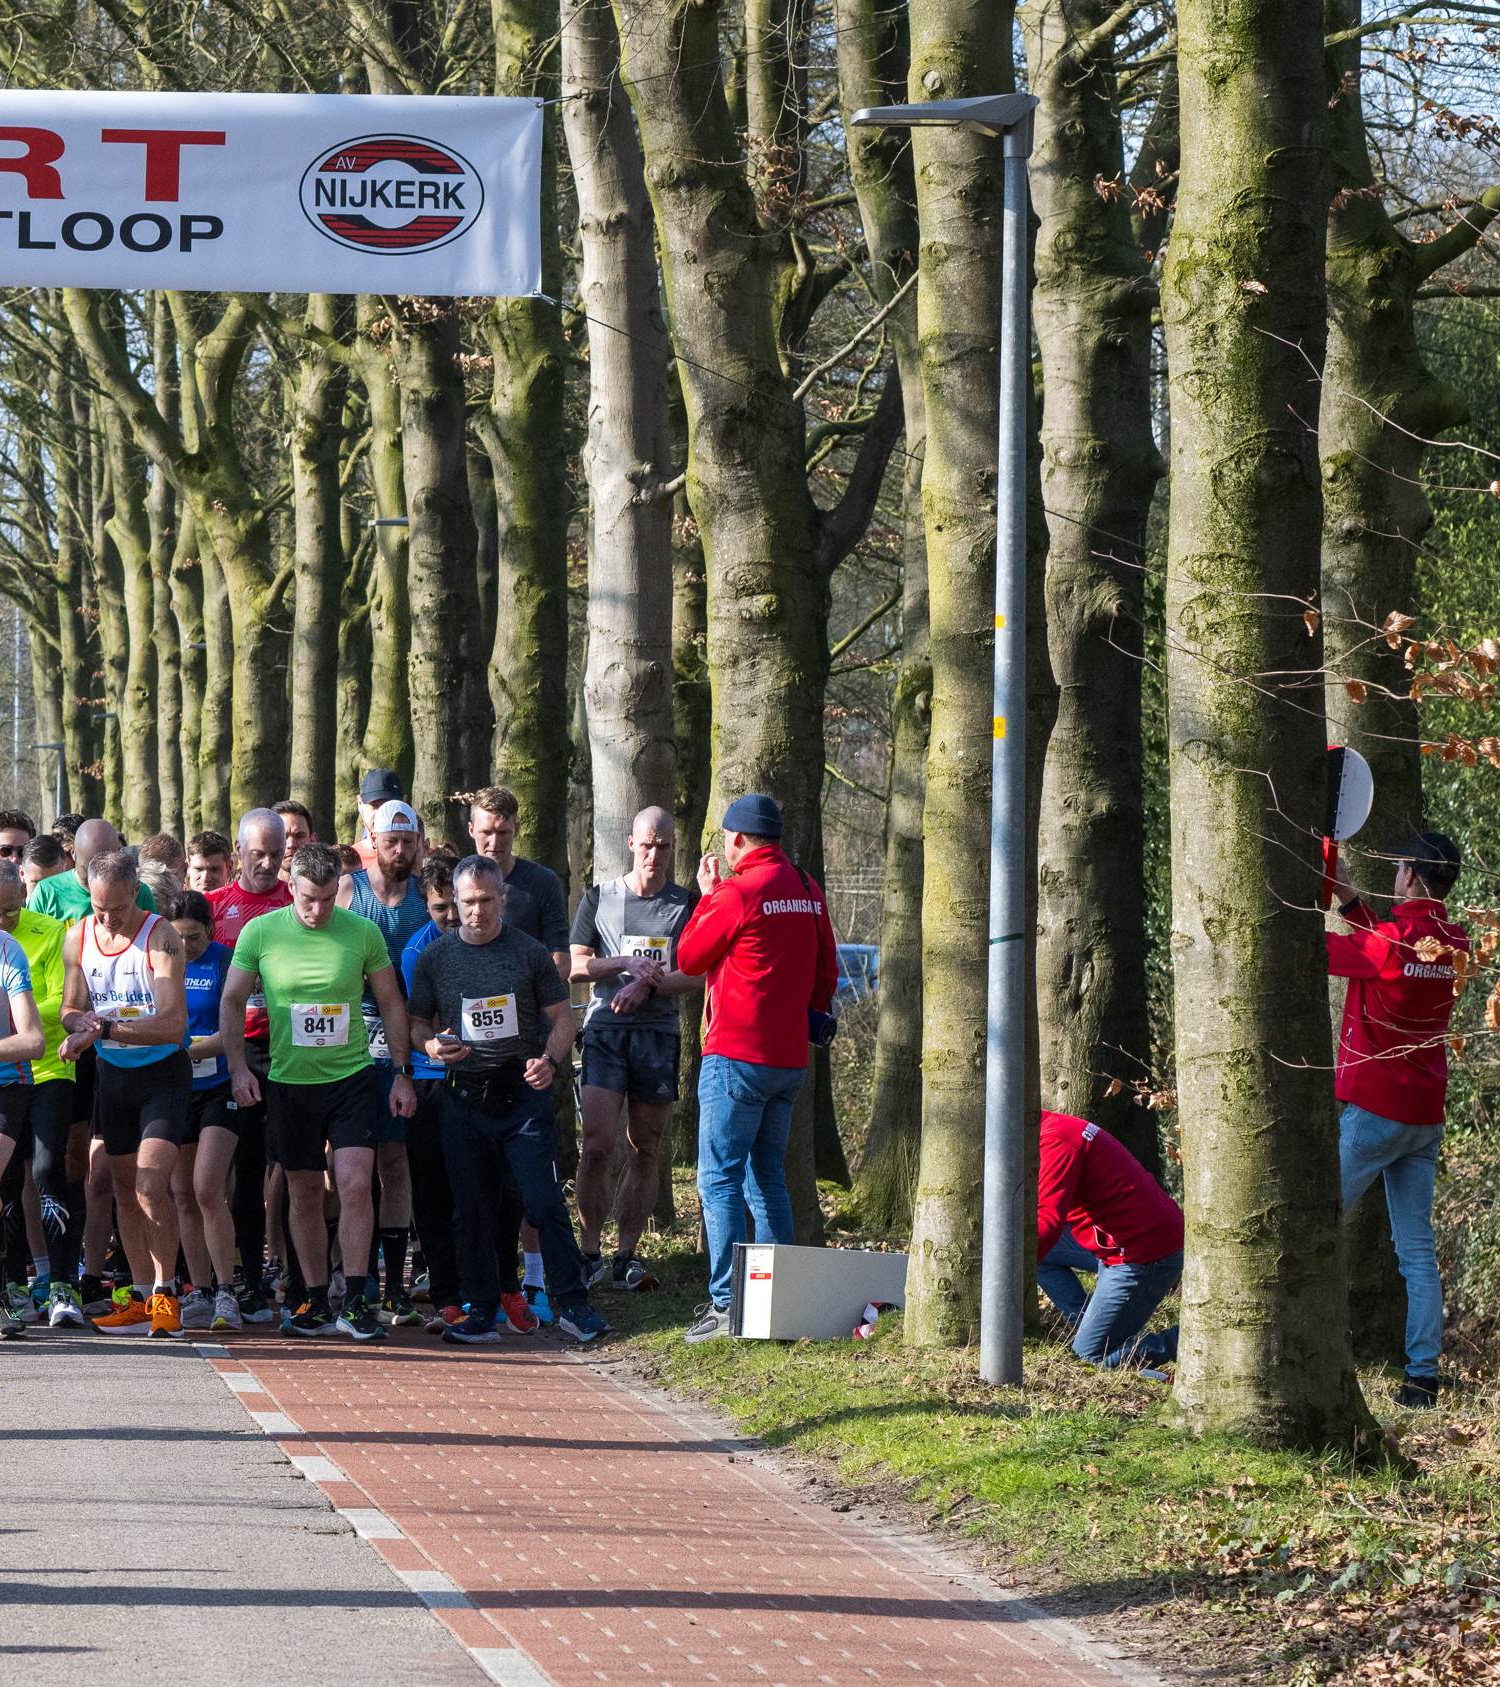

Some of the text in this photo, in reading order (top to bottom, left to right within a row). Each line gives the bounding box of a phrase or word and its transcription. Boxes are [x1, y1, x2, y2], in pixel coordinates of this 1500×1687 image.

[335, 155, 356, 170] AV
[313, 177, 466, 210] NIJKERK
[304, 1017, 335, 1034] 841
[471, 1009, 504, 1028] 855
